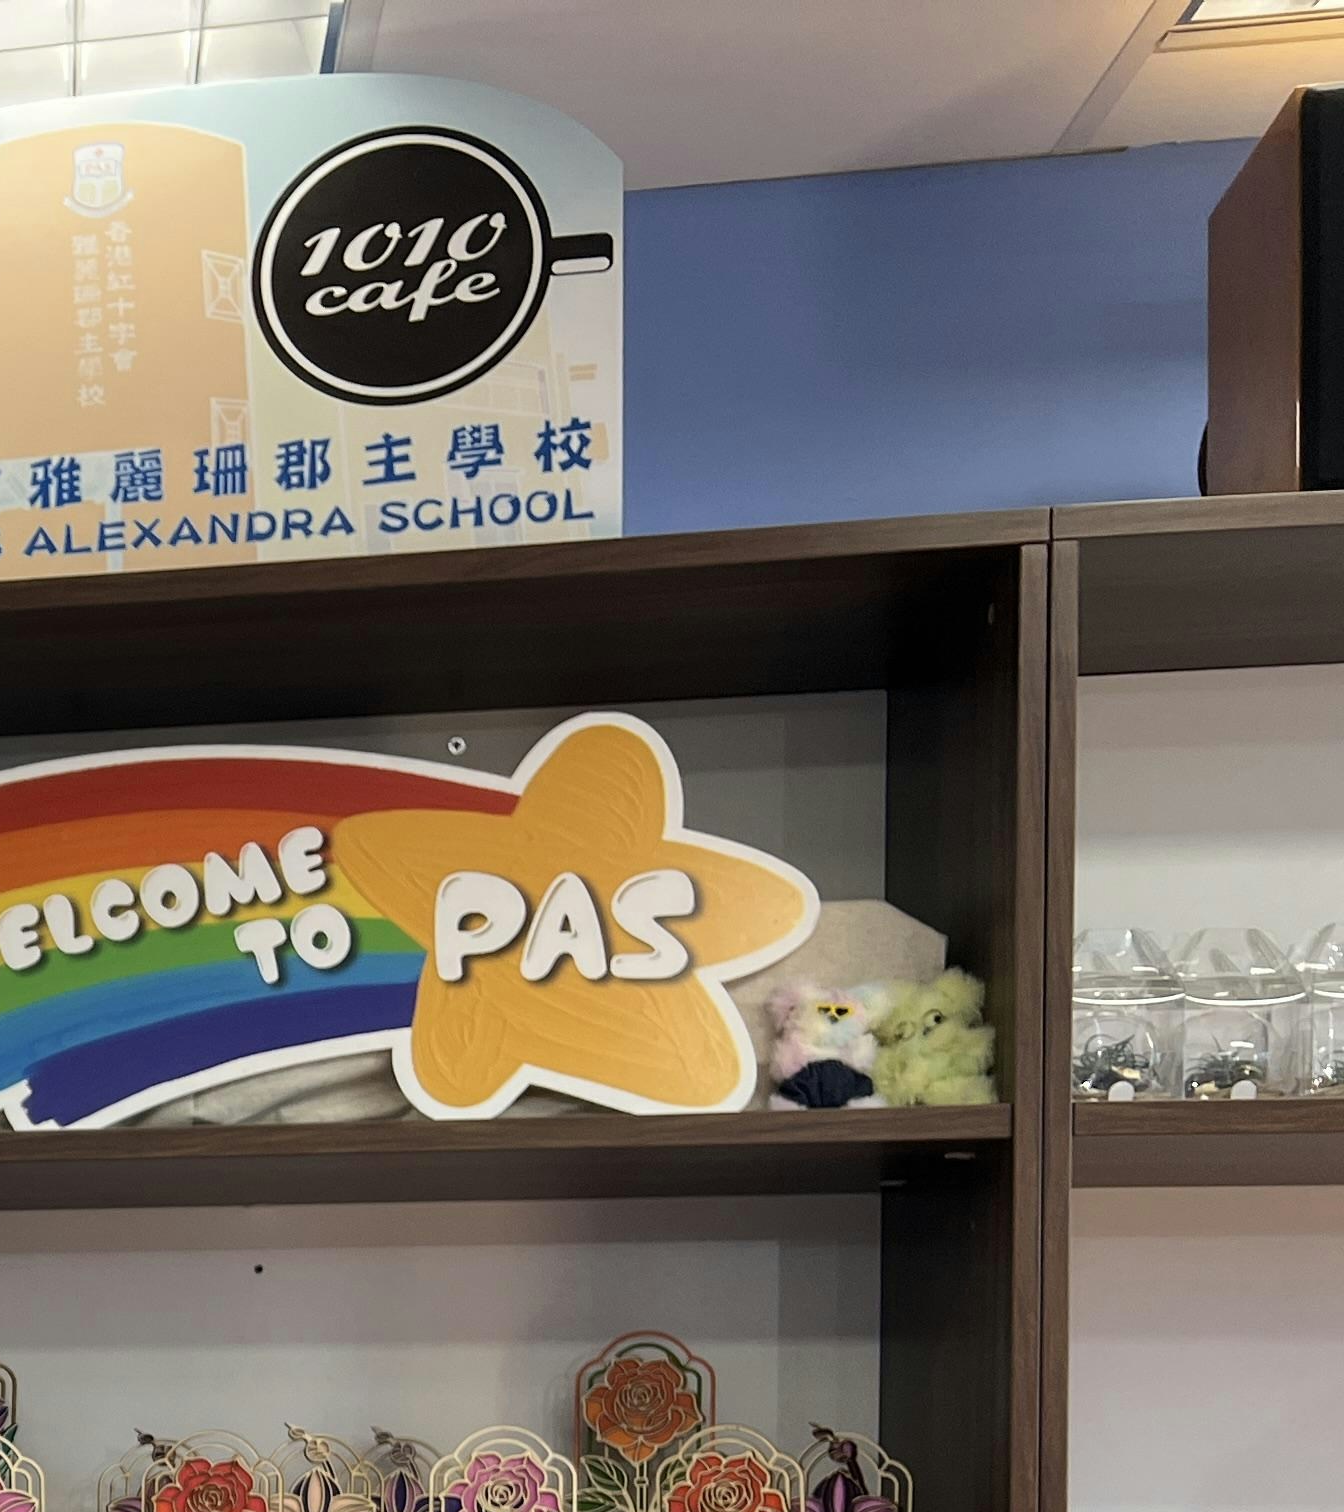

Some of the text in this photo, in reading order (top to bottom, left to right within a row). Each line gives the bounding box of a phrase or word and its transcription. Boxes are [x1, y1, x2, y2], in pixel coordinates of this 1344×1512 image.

[300, 212, 507, 277] 1010
[305, 258, 500, 322] cafe
[23, 505, 355, 557] ALEXANDRA
[379, 489, 595, 534] SCHOOL
[233, 904, 353, 984] TO
[431, 867, 696, 982] PAS
